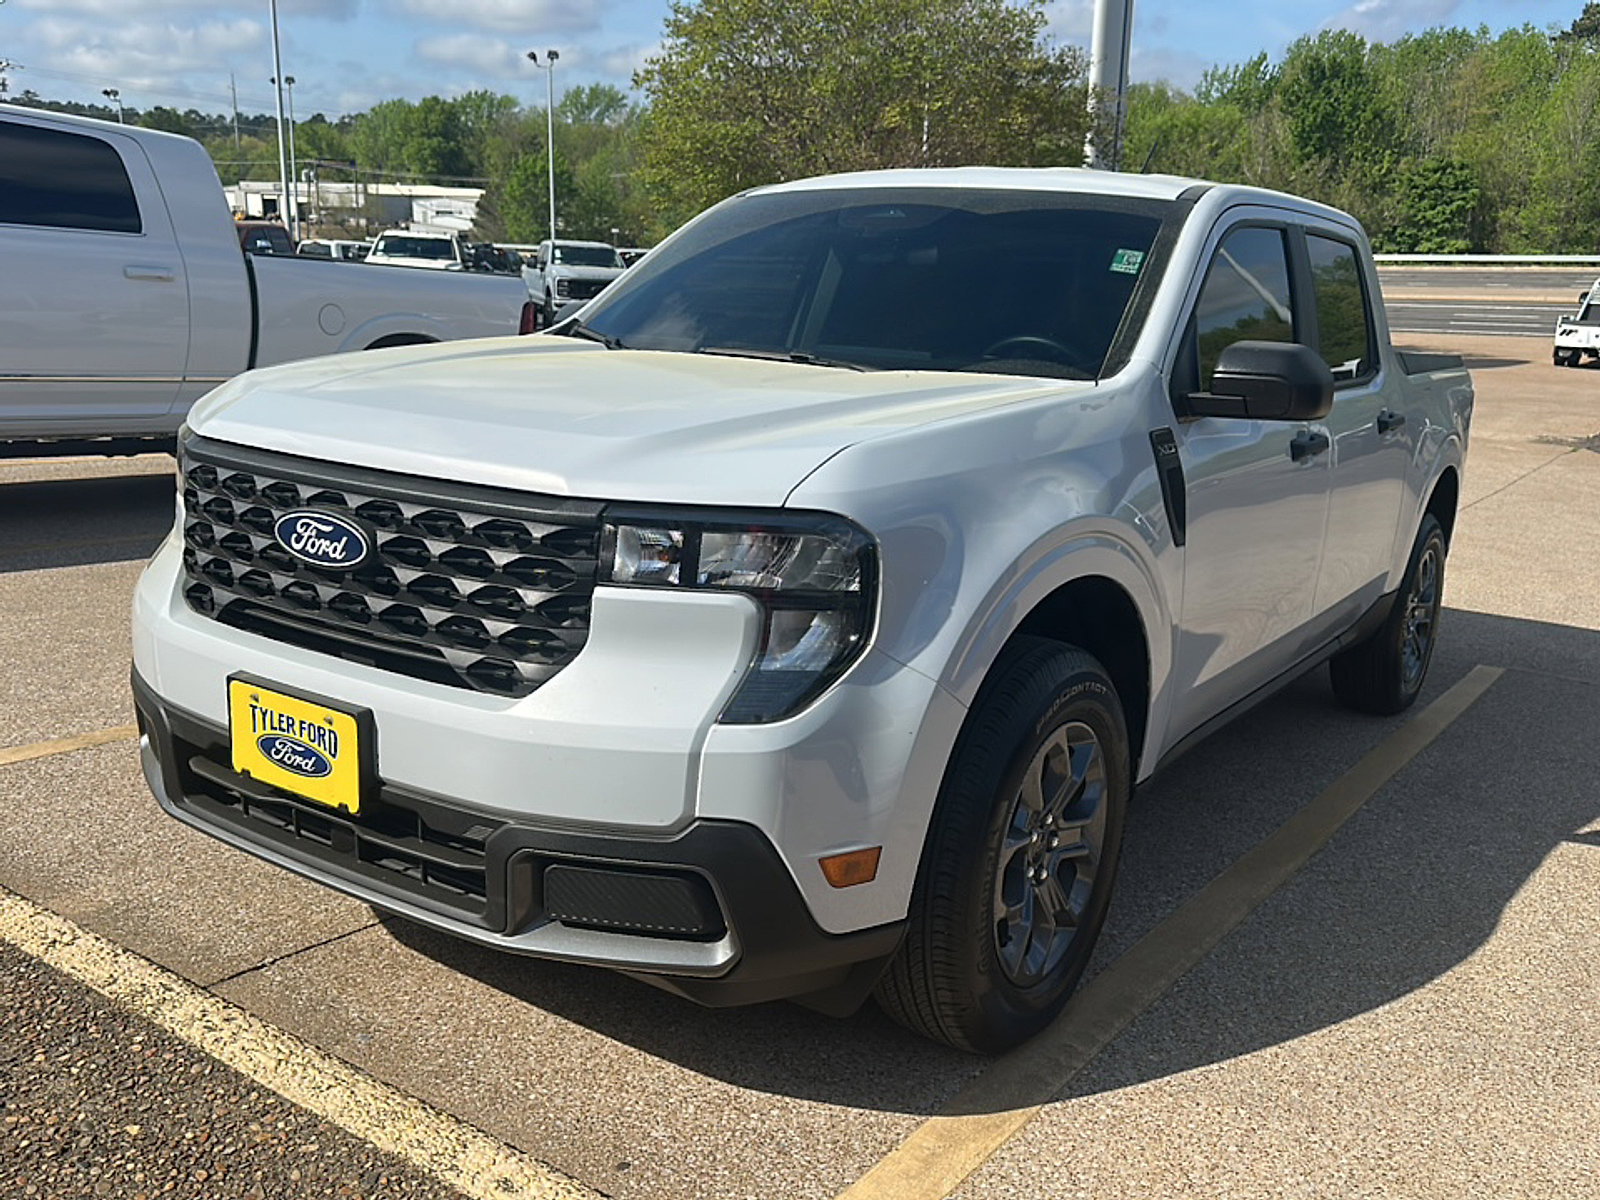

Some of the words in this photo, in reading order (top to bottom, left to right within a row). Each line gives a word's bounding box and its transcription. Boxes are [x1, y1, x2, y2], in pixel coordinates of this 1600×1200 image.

[291, 518, 347, 560] Ford
[249, 703, 296, 736] TYLER
[299, 719, 338, 759] FORD
[271, 738, 316, 772] Ford
